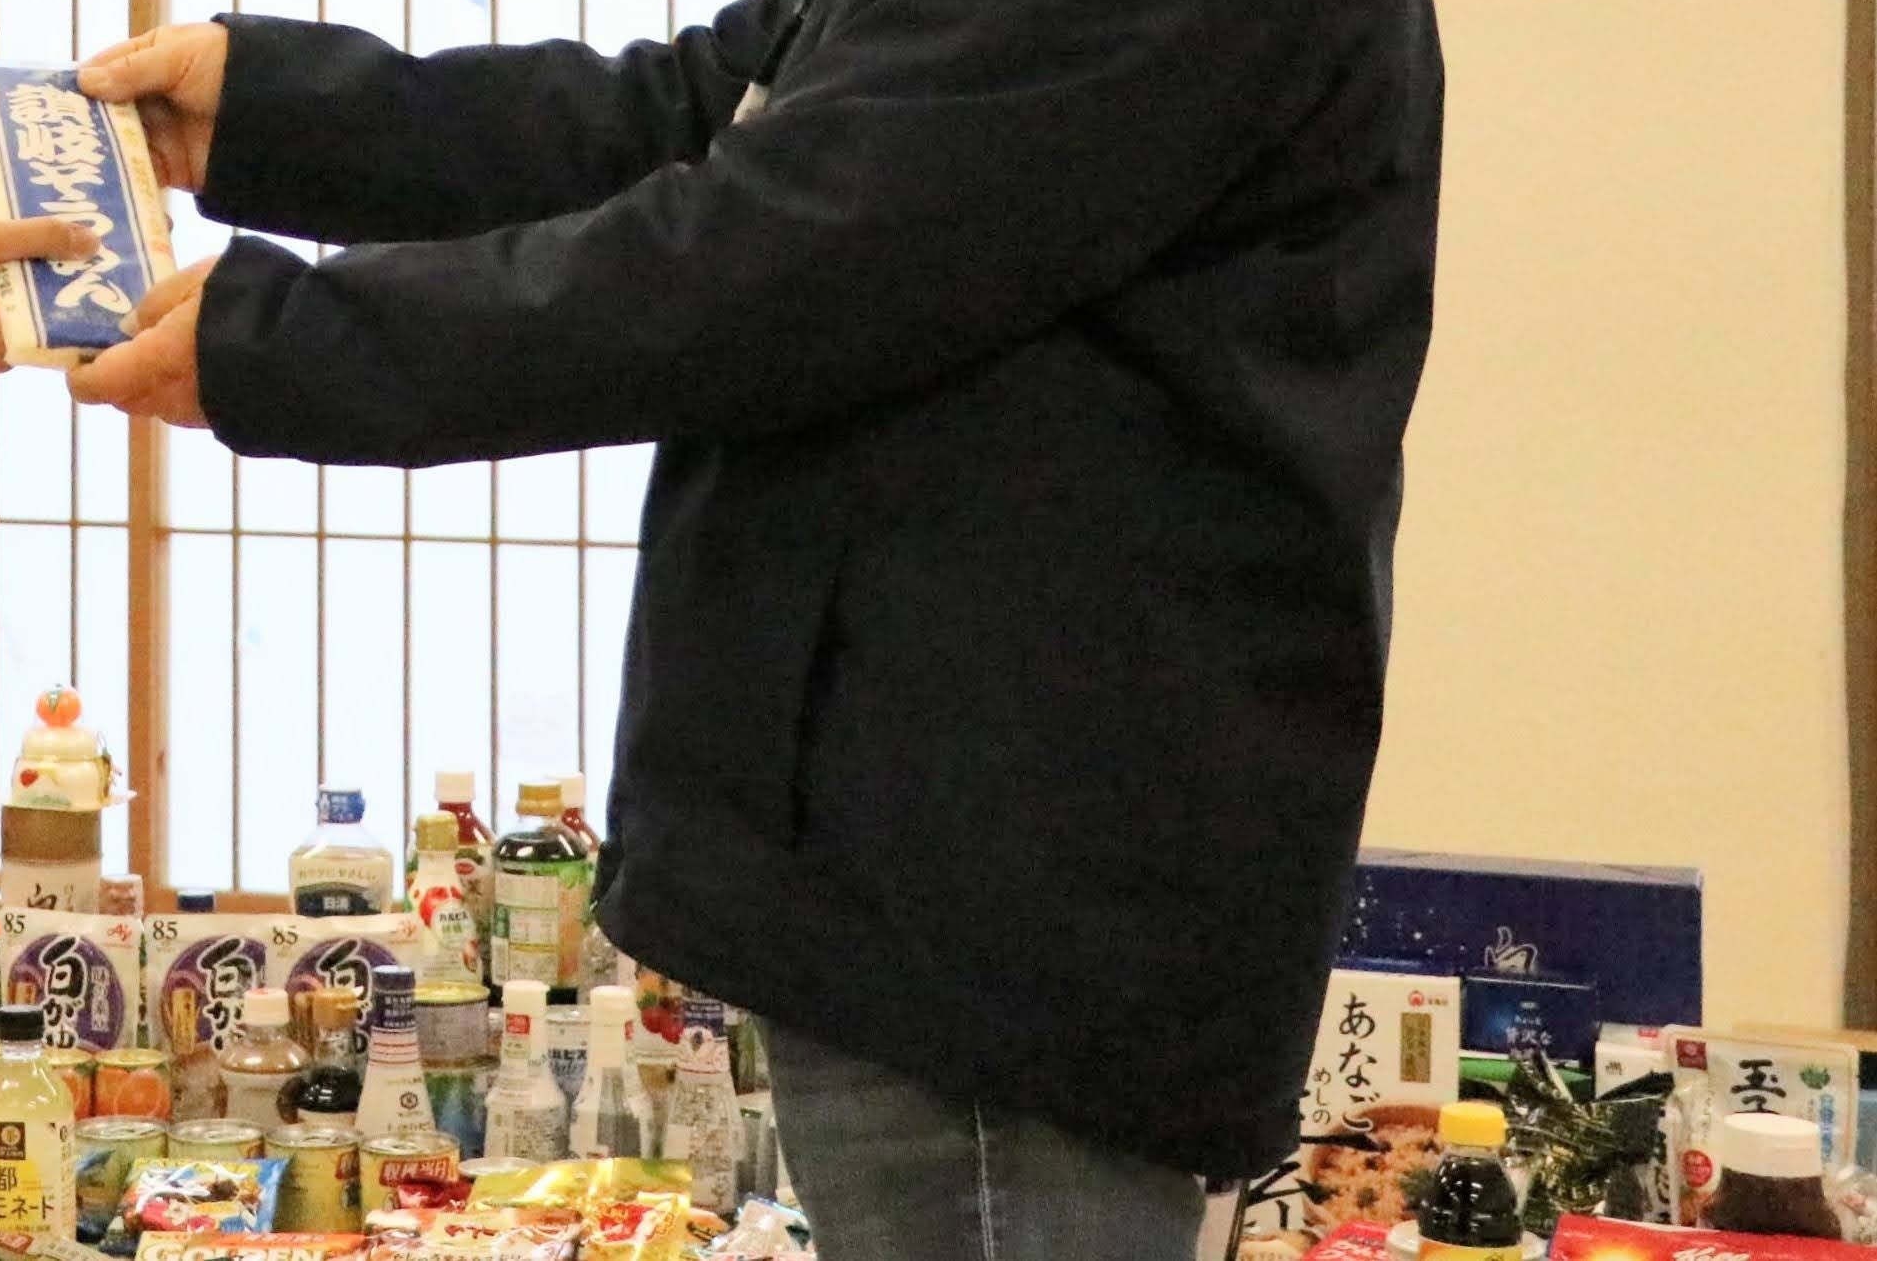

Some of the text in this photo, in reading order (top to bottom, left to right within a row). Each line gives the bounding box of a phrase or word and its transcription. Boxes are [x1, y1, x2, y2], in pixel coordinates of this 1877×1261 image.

[4, 913, 26, 934] 85
[152, 920, 178, 940] 85
[273, 926, 298, 945] 85
[1338, 992, 1381, 1131] あなご
[1312, 1067, 1332, 1125] めしの
